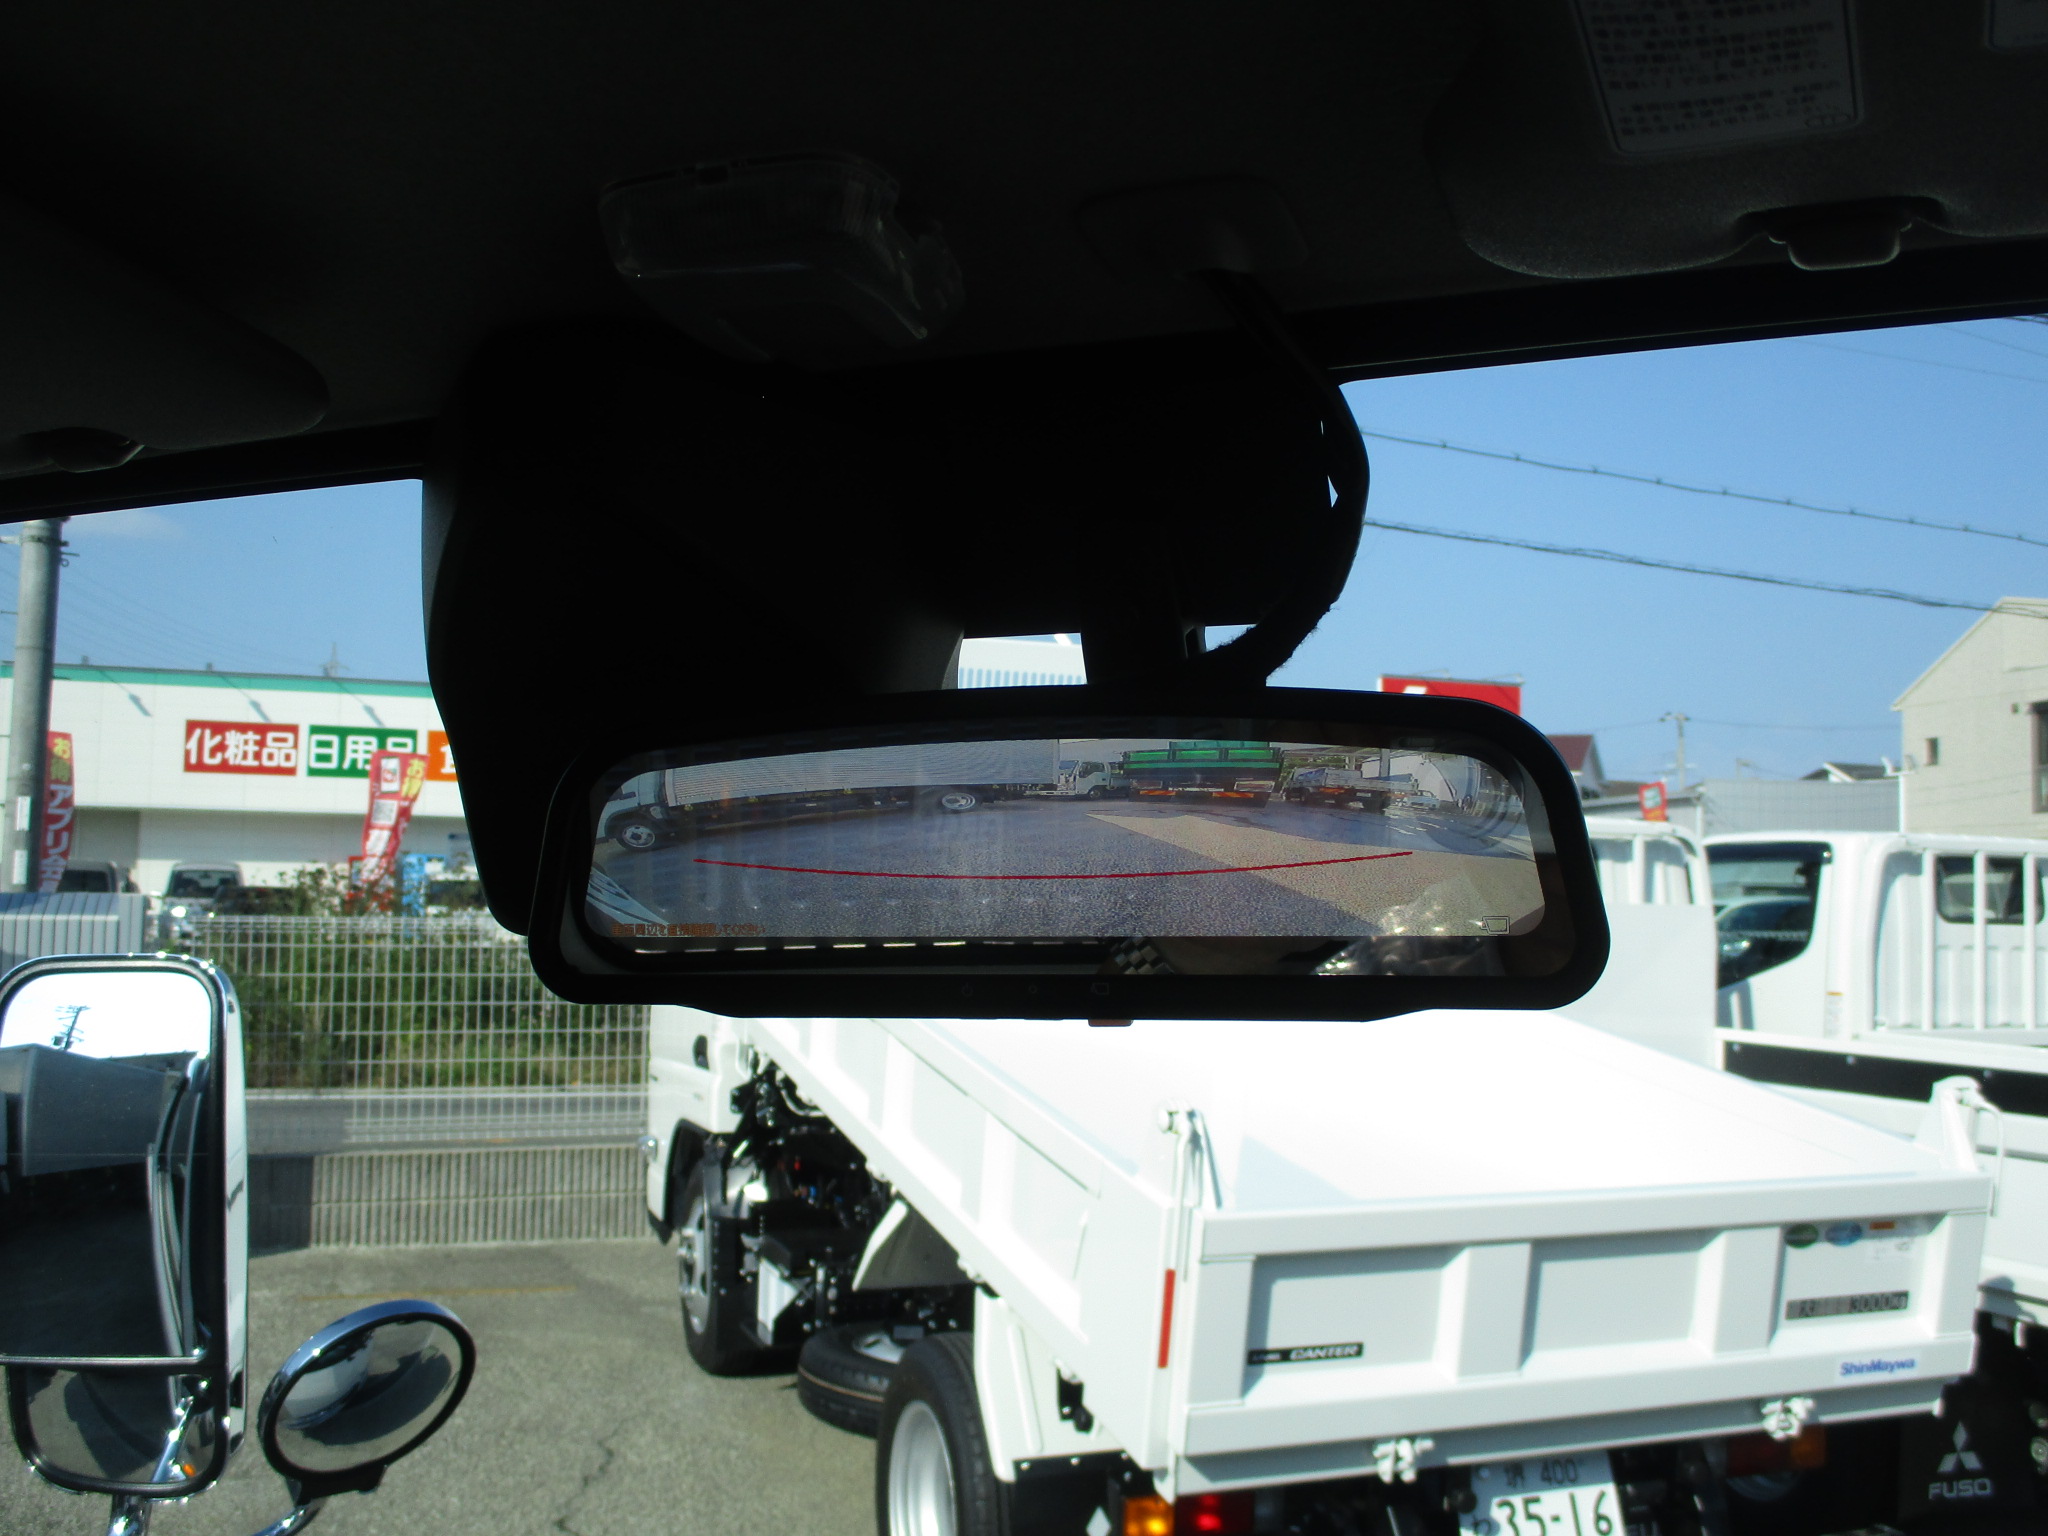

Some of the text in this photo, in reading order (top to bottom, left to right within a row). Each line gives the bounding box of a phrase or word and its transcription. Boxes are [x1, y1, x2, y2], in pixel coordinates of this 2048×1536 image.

[186, 728, 297, 768] 化粧品
[1840, 1359, 1916, 1376] ShinMaywa
[1541, 1457, 1578, 1486] 400
[1928, 1477, 1994, 1500] FUSO
[1496, 1491, 1612, 1536] 35-16
